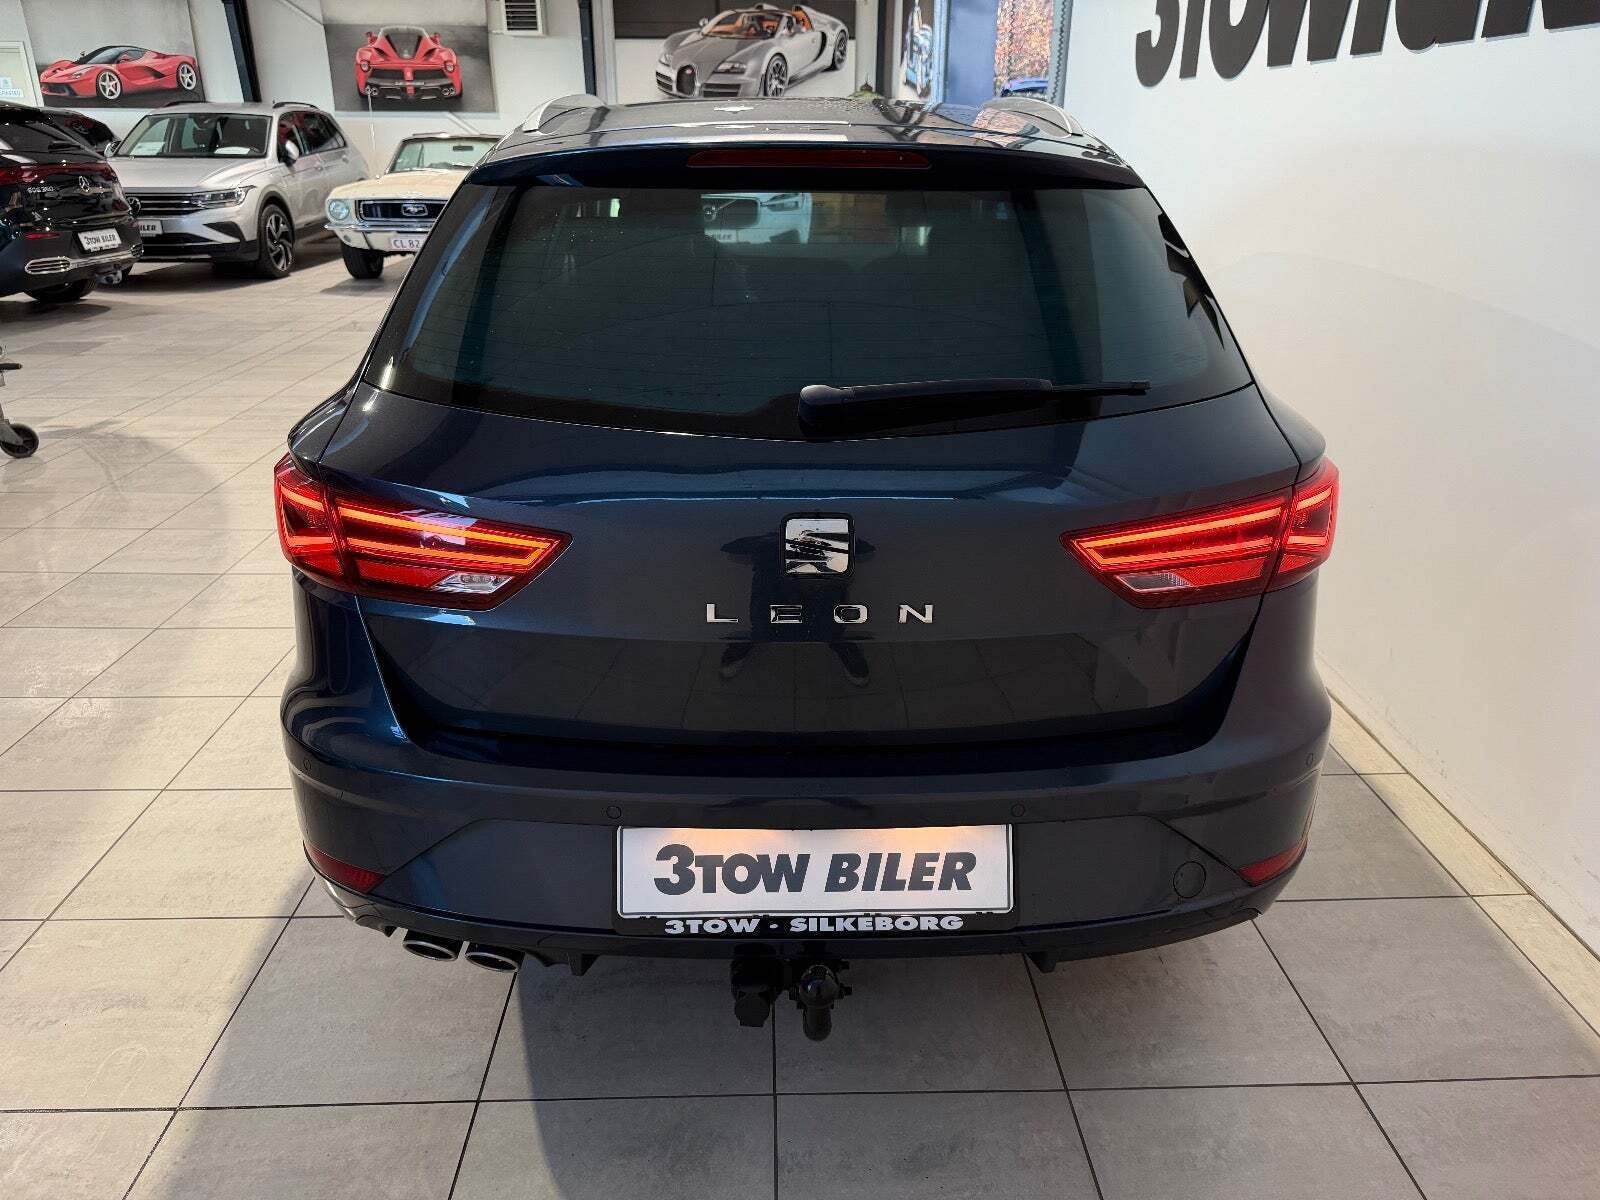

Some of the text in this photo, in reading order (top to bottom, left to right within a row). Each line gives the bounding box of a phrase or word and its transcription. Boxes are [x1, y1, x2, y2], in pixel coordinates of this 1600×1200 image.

[393, 239, 406, 249] CL
[706, 603, 934, 624] LEON
[653, 843, 977, 896] 3TOW BILER
[664, 915, 964, 934] 3TOW SILKEBORG
